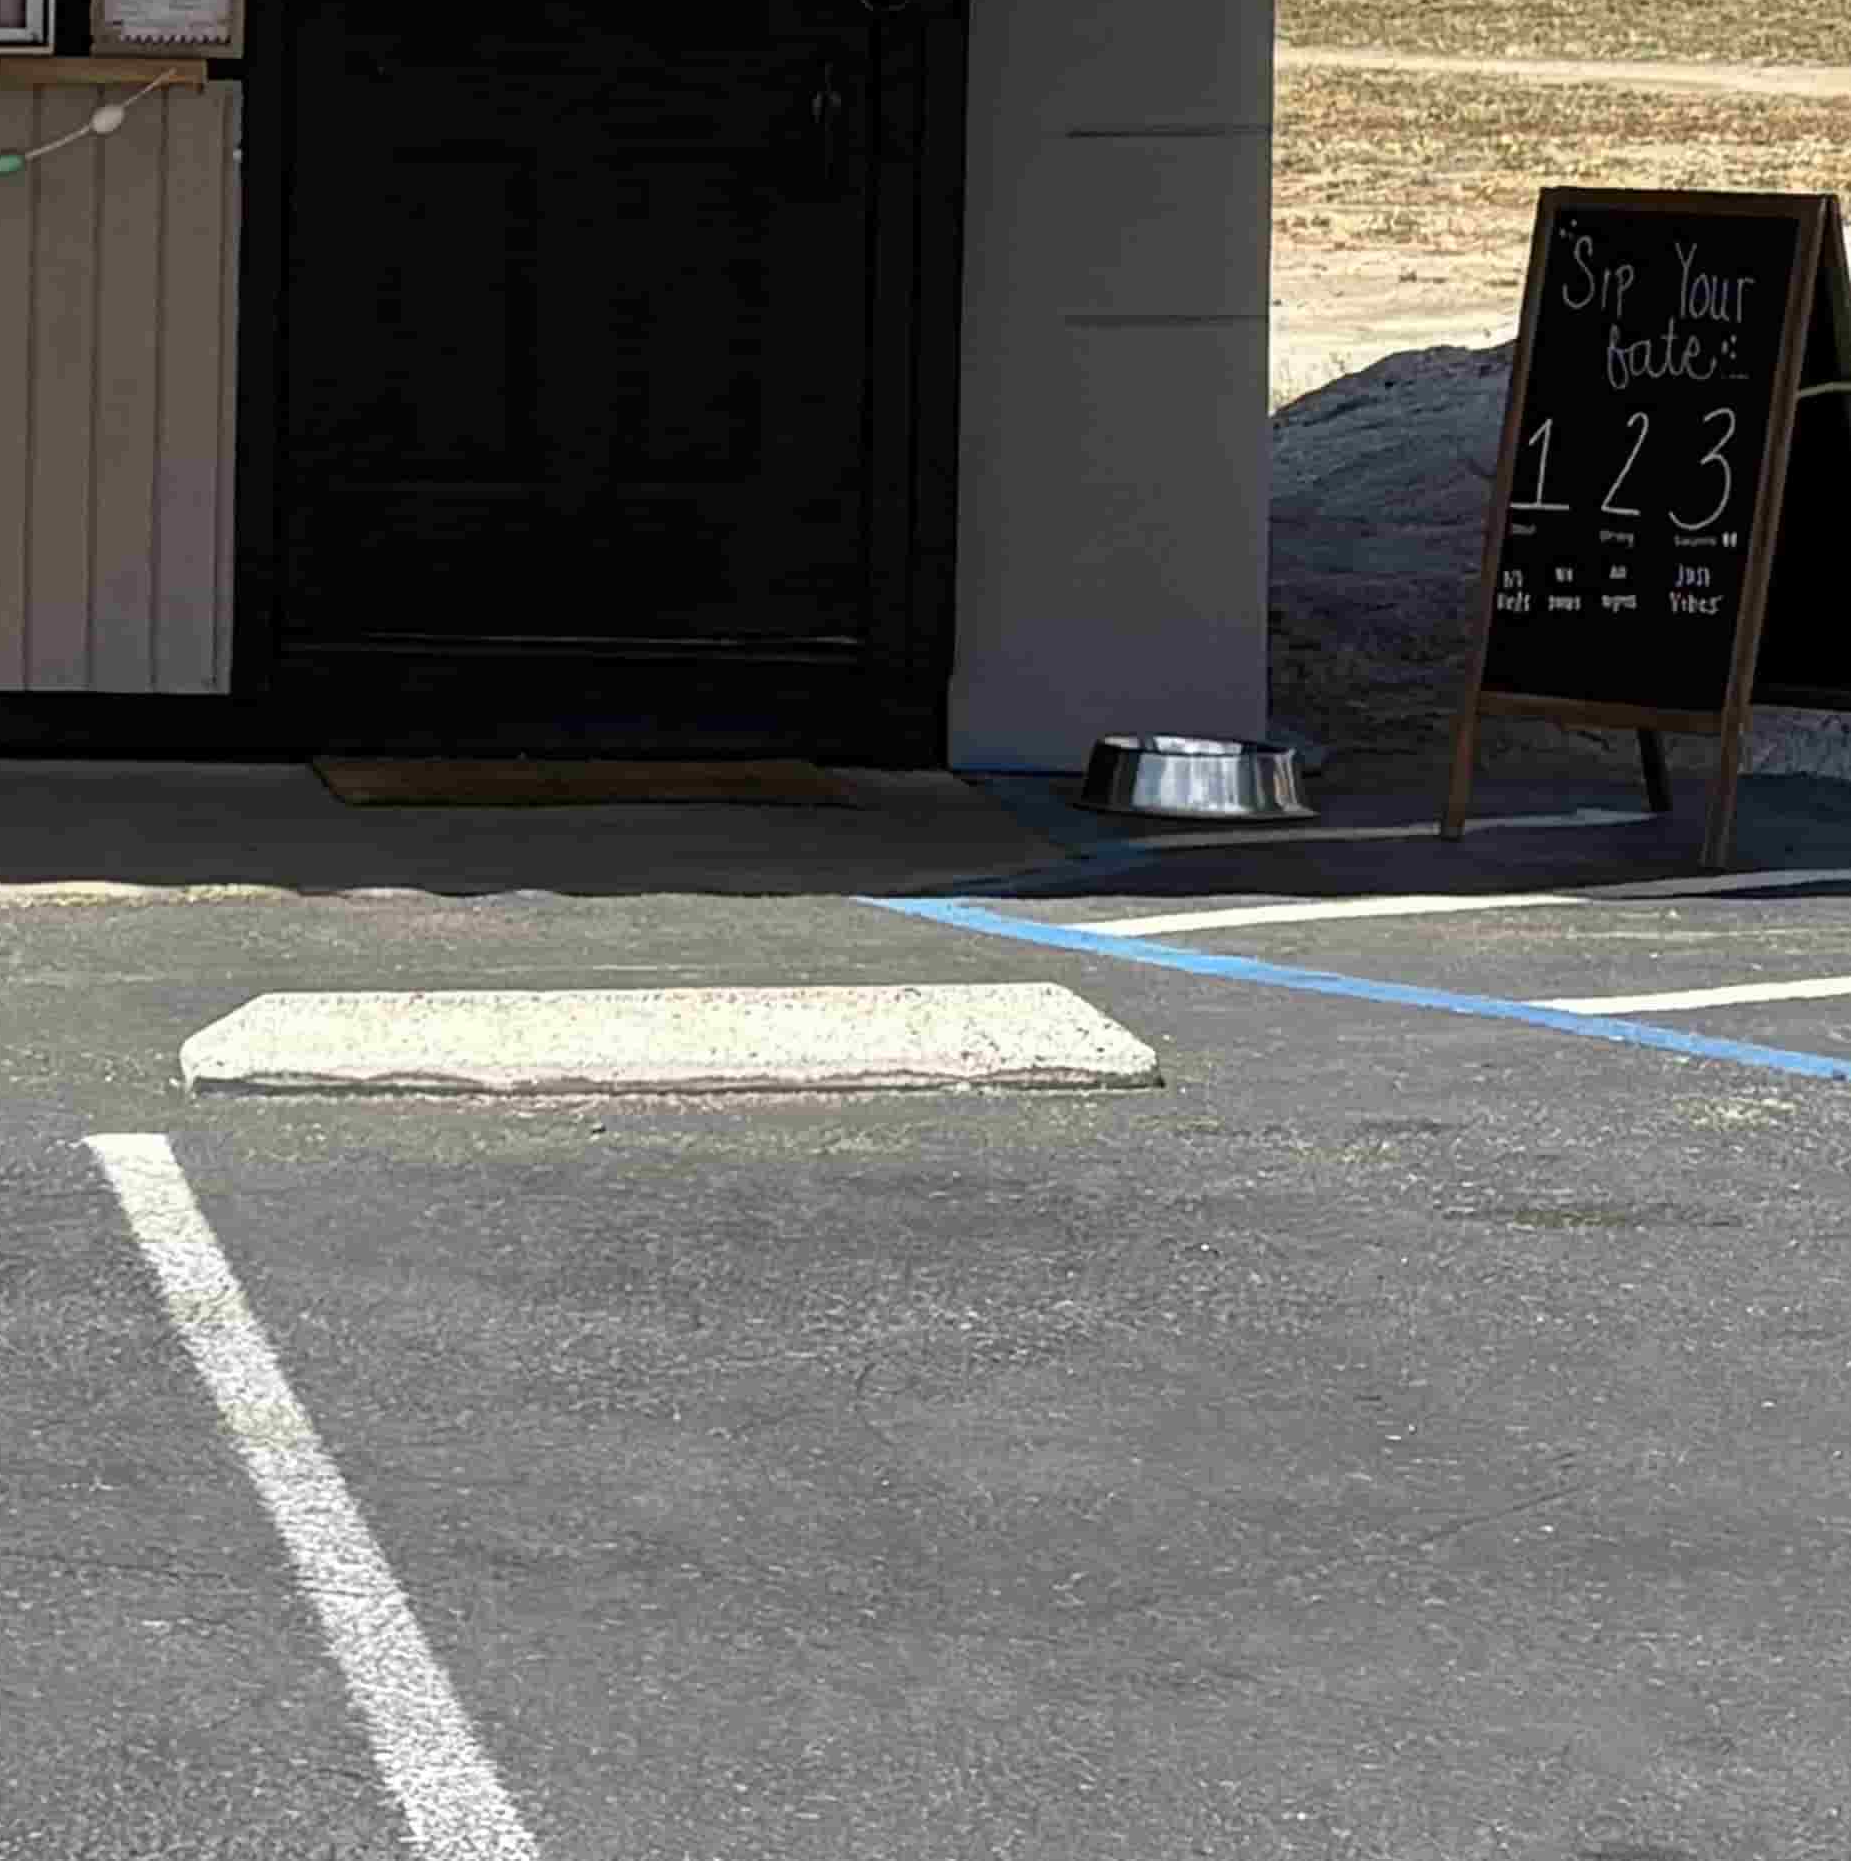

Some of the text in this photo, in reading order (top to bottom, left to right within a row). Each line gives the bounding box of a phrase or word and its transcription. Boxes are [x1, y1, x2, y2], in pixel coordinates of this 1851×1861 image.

[1561, 234, 1755, 323] Sip Your
[1509, 407, 1736, 530] 1 2 3
